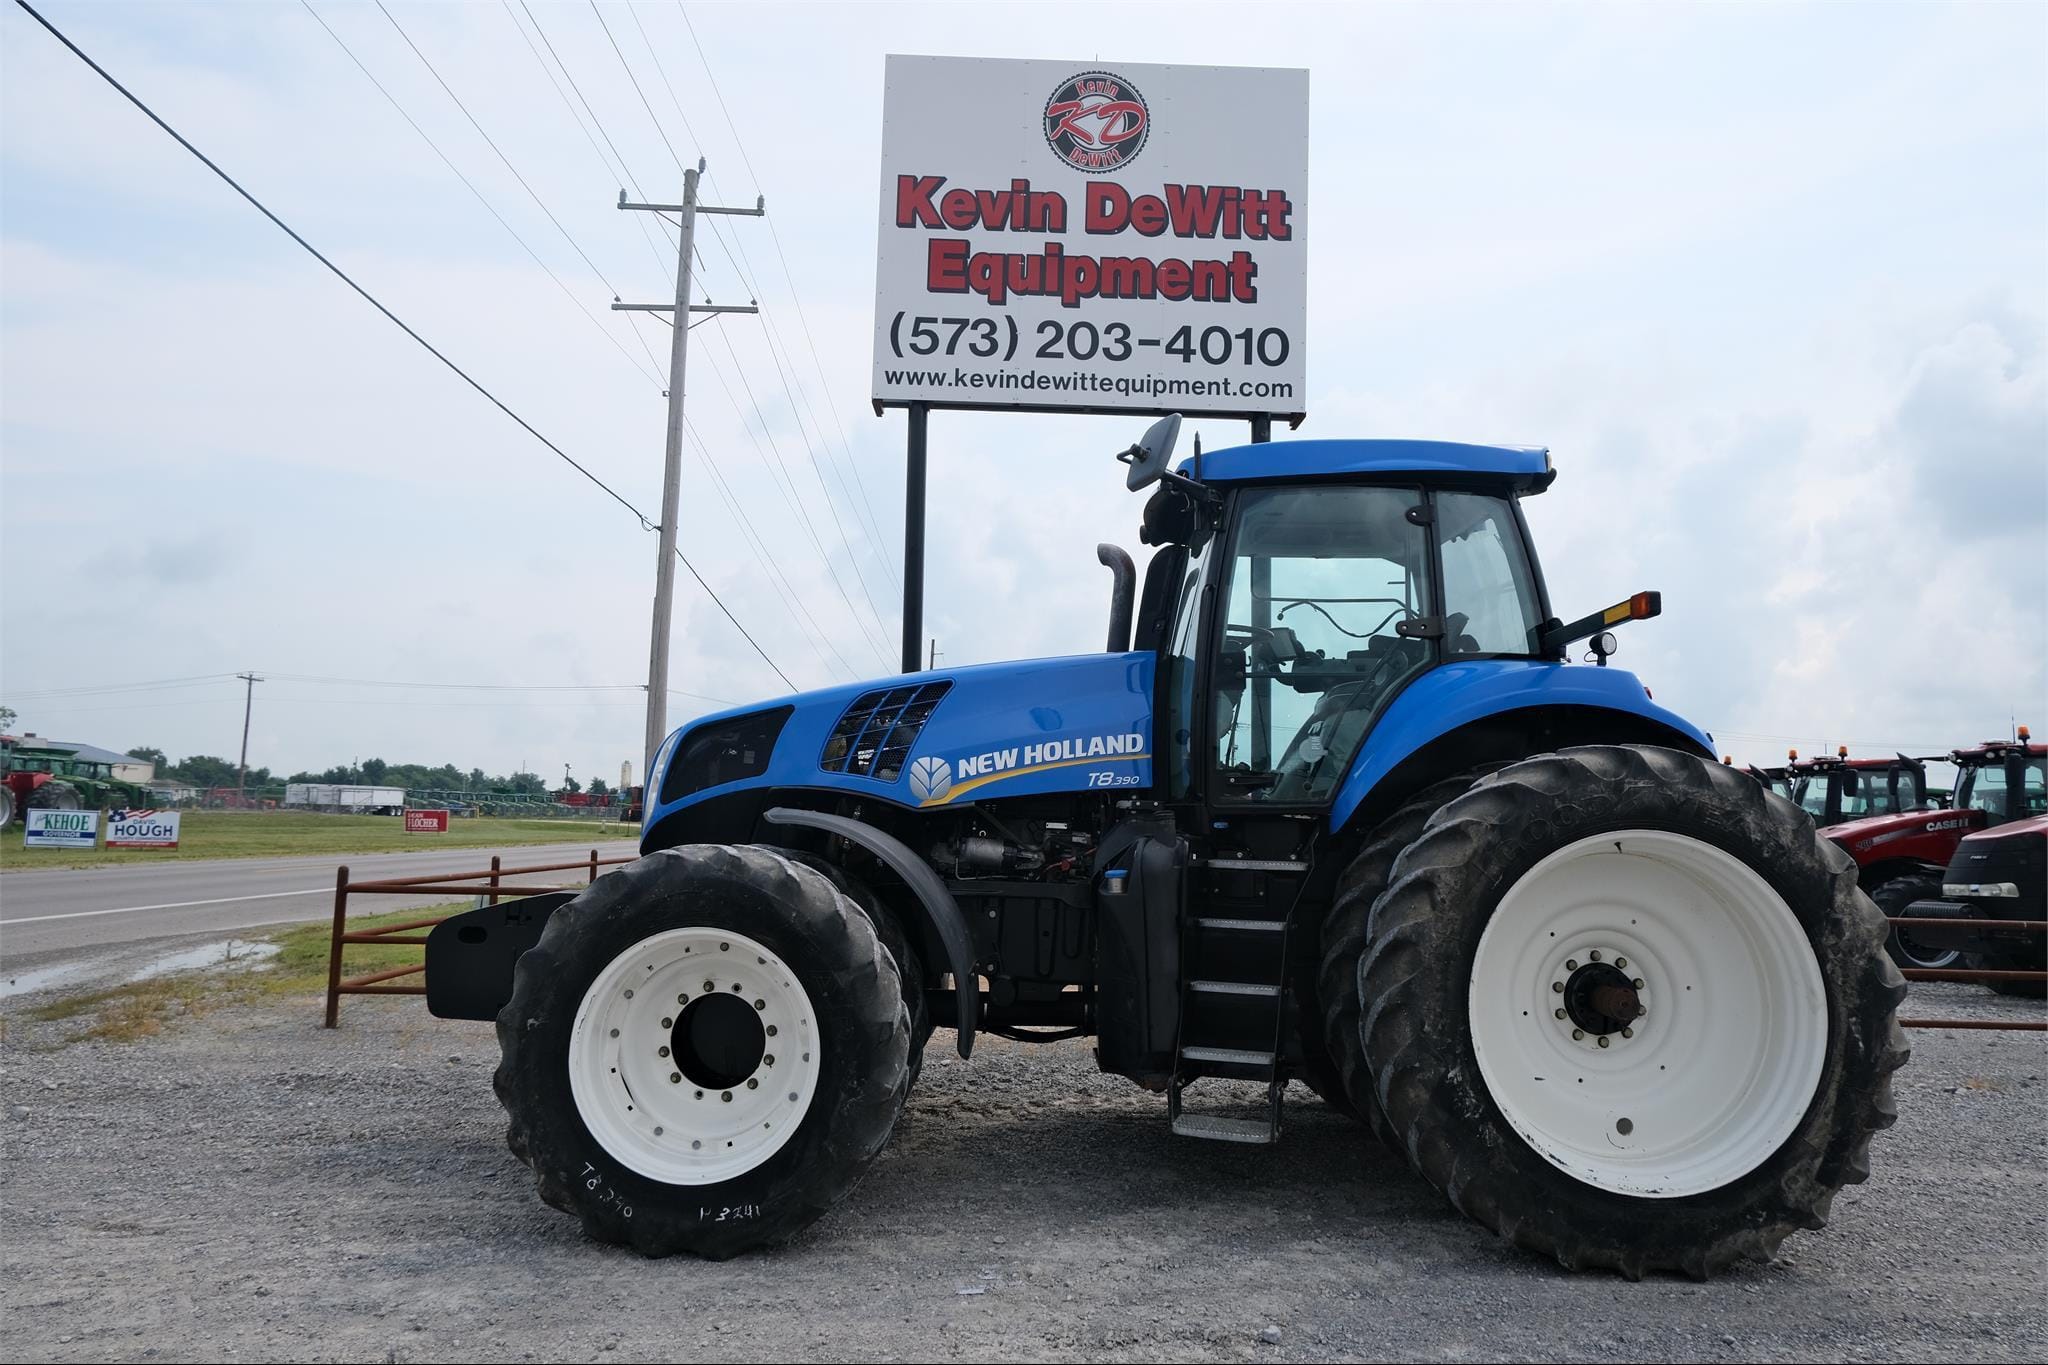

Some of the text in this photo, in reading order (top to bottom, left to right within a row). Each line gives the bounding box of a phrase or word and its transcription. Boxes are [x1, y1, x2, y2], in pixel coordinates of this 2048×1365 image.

[1075, 80, 1119, 97] Kevin
[1047, 101, 1146, 144] KD
[1069, 147, 1122, 167] DeWitt
[896, 174, 1292, 241] Kevin DeWitt
[927, 238, 1257, 308] Equipment
[890, 312, 1290, 366] (573) 203-4010
[884, 367, 1293, 398] www.kevindewittequipment.com
[958, 733, 1144, 779] NEW HOLLAND
[44, 814, 89, 831] KEHOE
[114, 824, 173, 837] HOUGH
[1926, 819, 1957, 832] CASE
